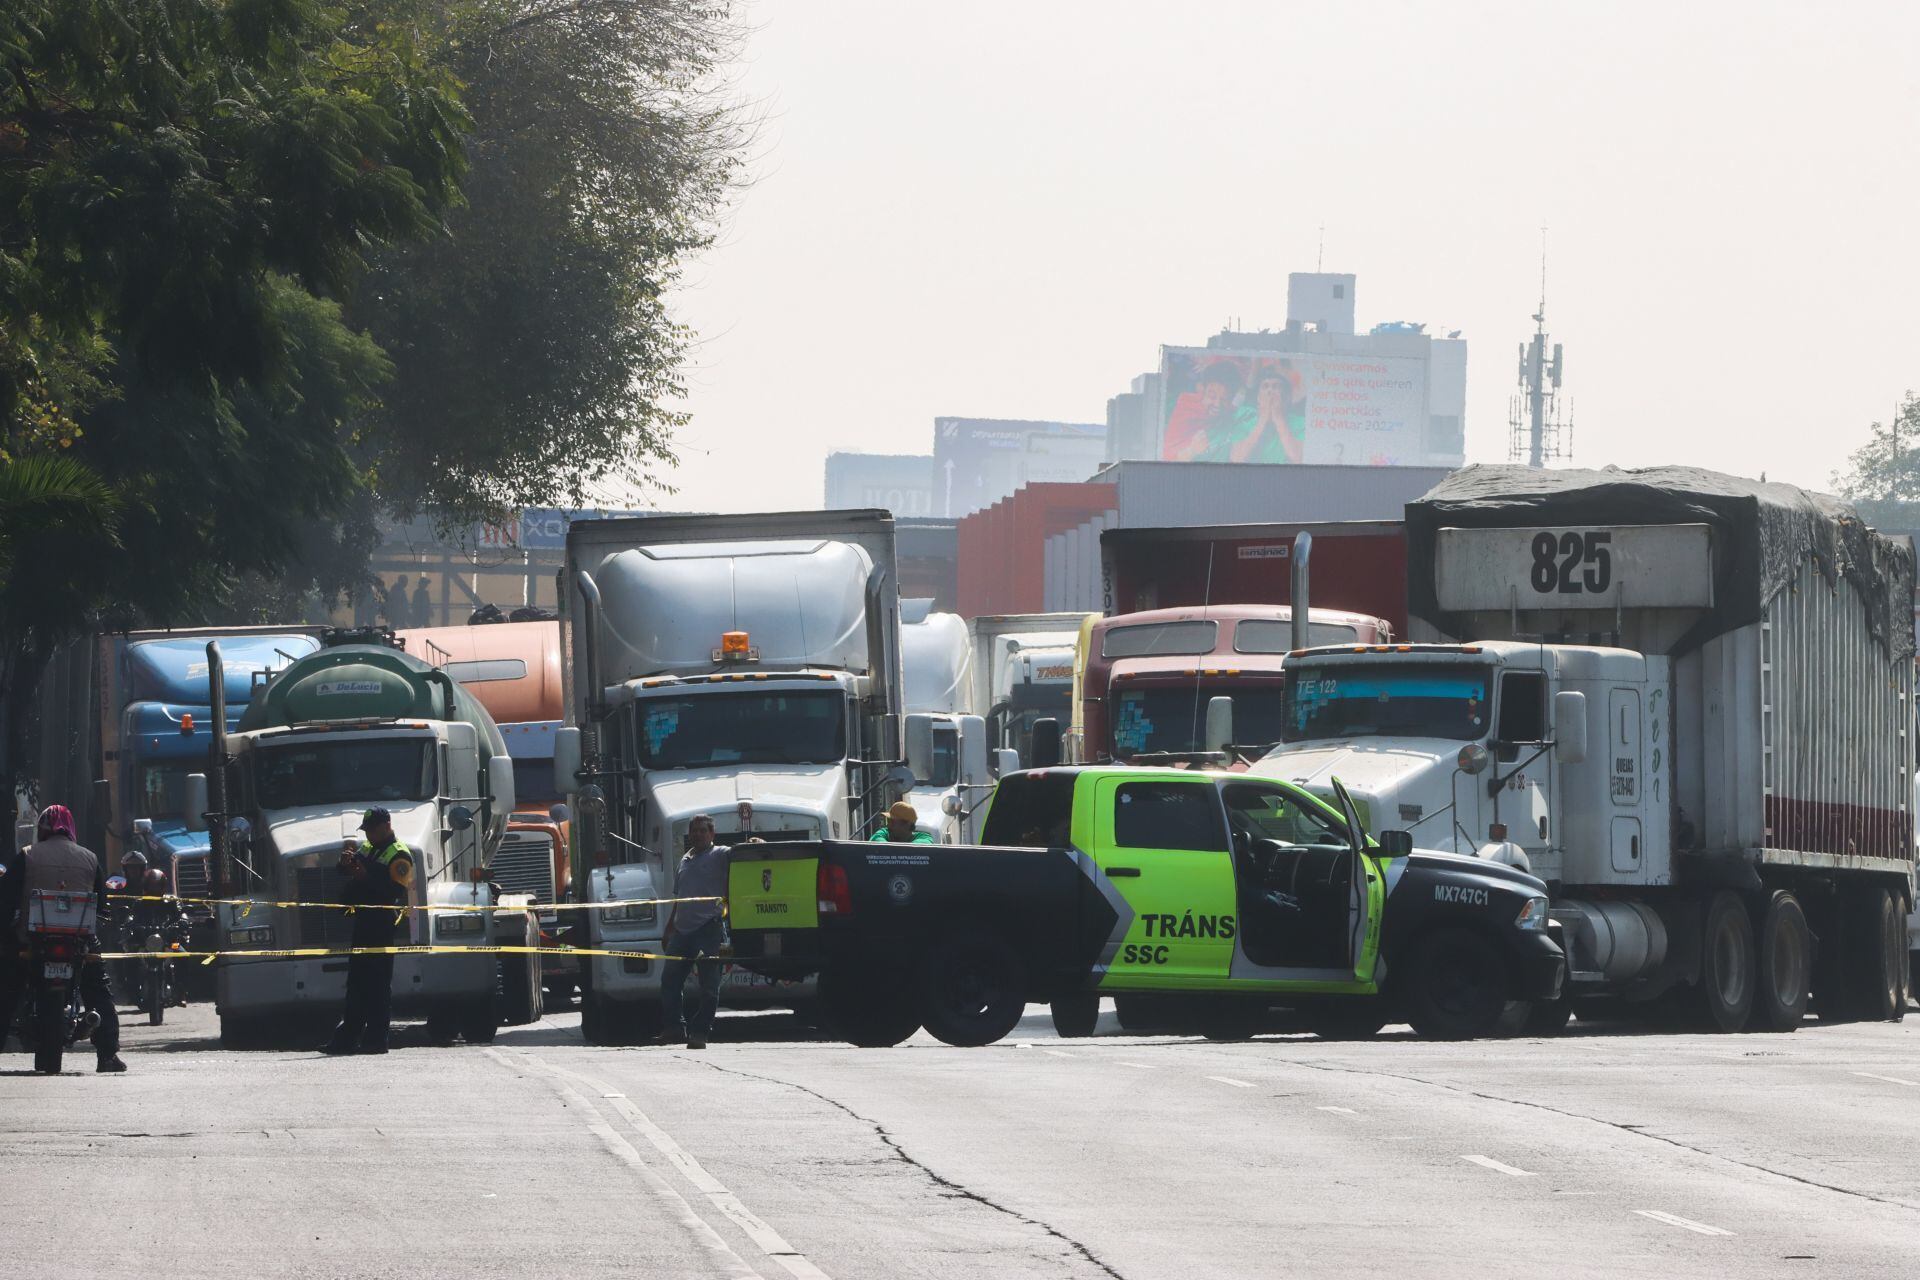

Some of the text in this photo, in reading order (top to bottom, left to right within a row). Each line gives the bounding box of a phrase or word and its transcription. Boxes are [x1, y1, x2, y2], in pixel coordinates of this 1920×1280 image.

[1368, 378, 1414, 391] quieren
[1334, 391, 1370, 401] todos
[1312, 404, 1329, 415] los
[1327, 418, 1363, 431] Qatar
[1531, 531, 1611, 594] 825
[1297, 679, 1337, 695] TE 122
[1616, 757, 1634, 774] QUEJAS
[1434, 885, 1489, 906] MX747C1
[1141, 908, 1235, 939] TRÁNS
[1123, 944, 1170, 965] SSC
